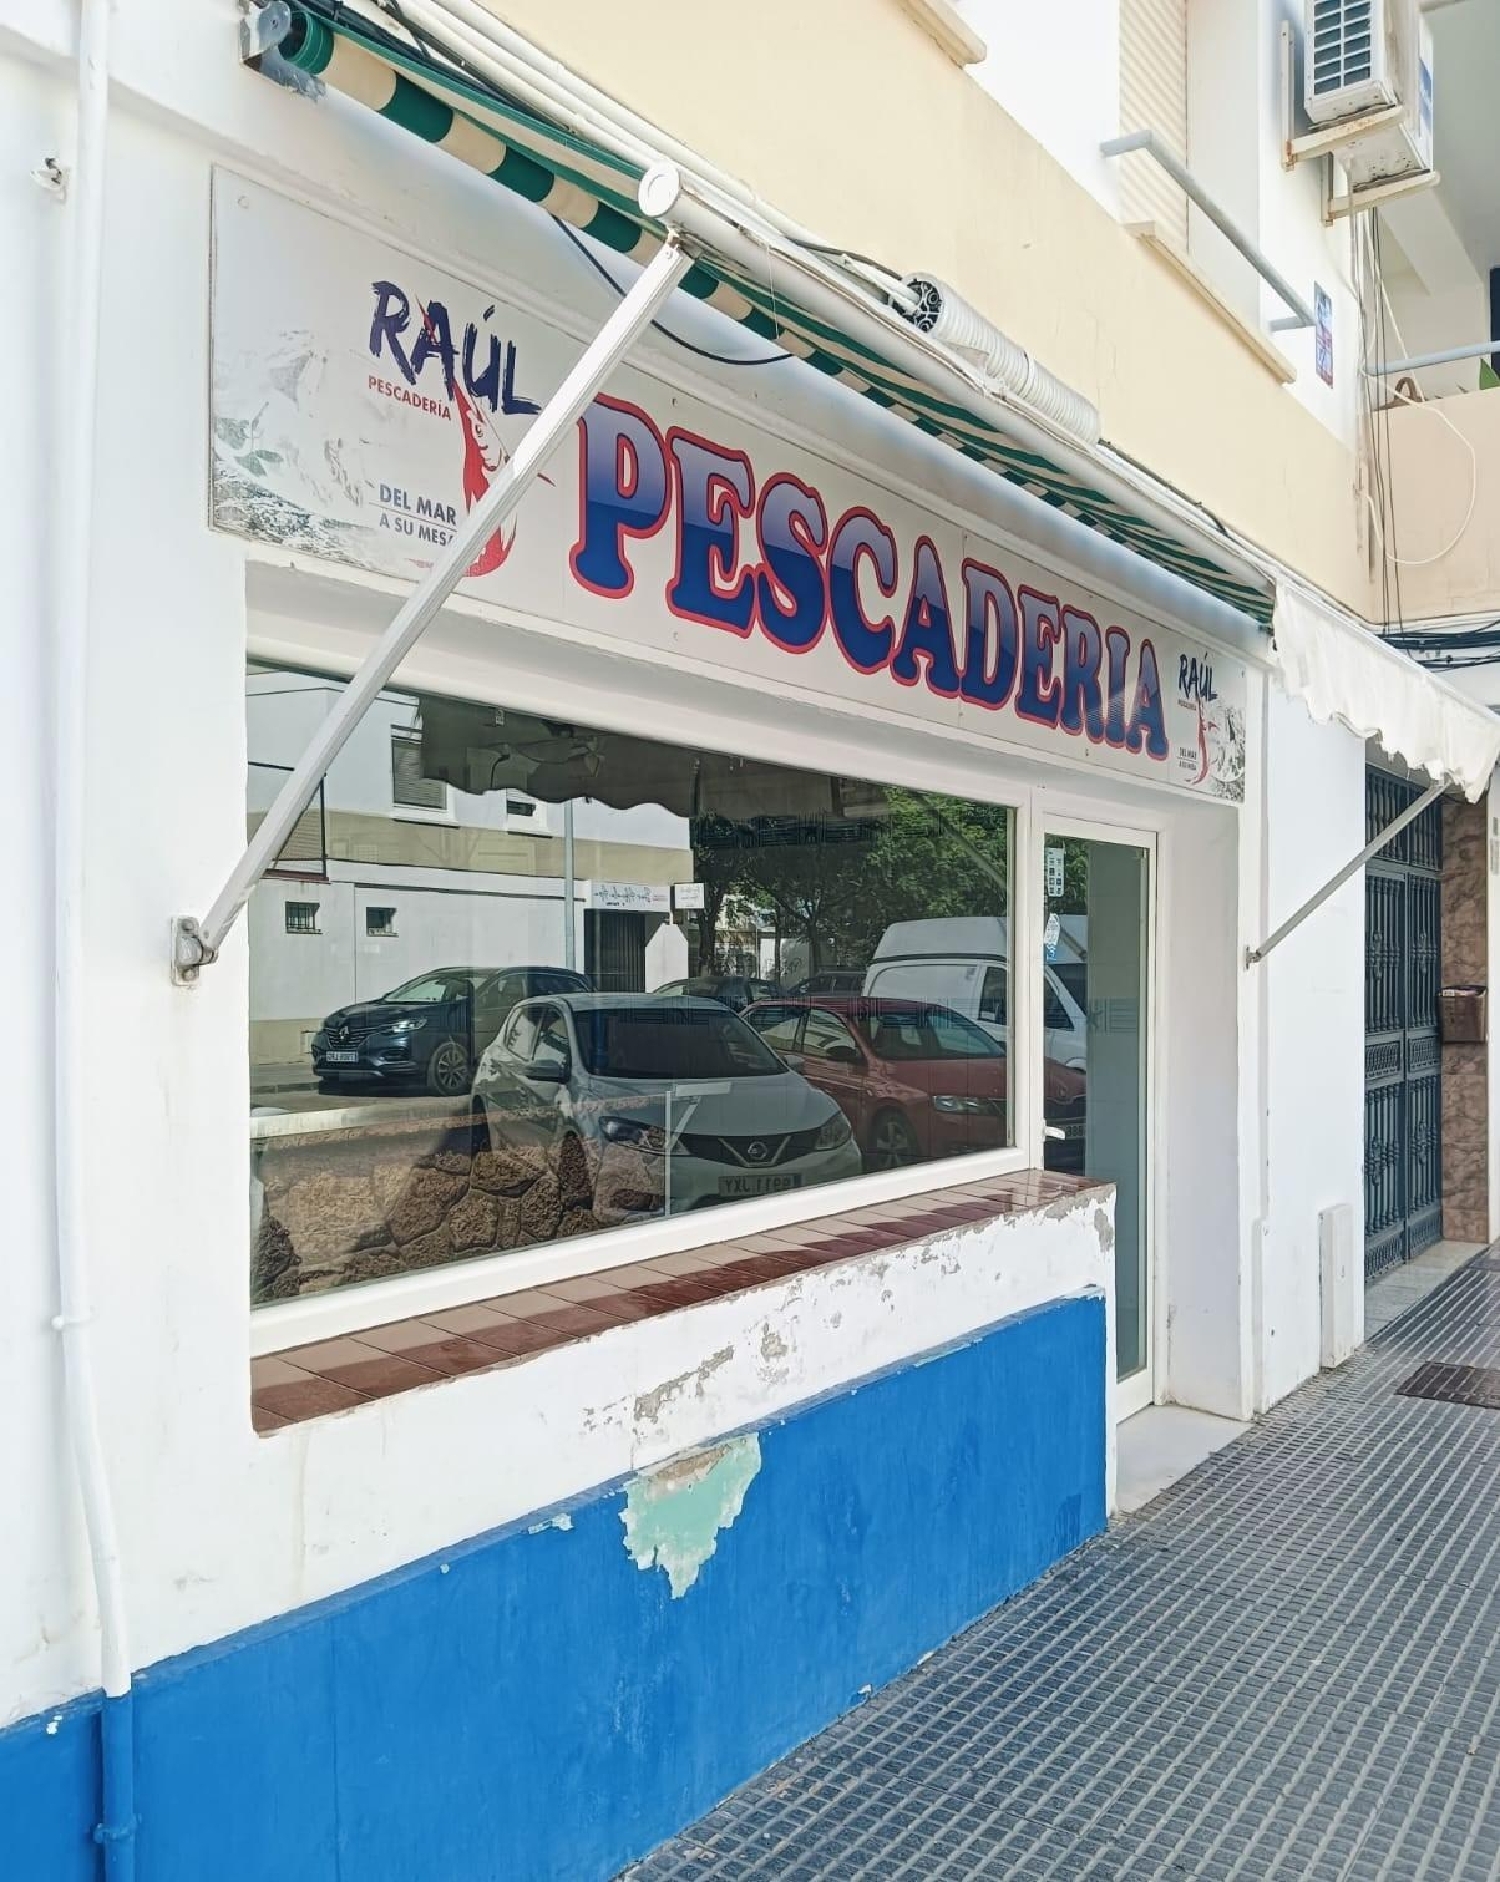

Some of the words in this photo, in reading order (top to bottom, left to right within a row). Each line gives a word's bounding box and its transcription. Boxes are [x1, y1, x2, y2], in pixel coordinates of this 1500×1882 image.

[369, 280, 542, 415] RAÚL
[380, 484, 411, 511] DEL
[416, 496, 457, 527] MAR
[380, 511, 390, 529] A
[394, 517, 414, 536] SU
[570, 393, 1169, 761] PESCADERIA
[1179, 651, 1218, 702] RAÚL
